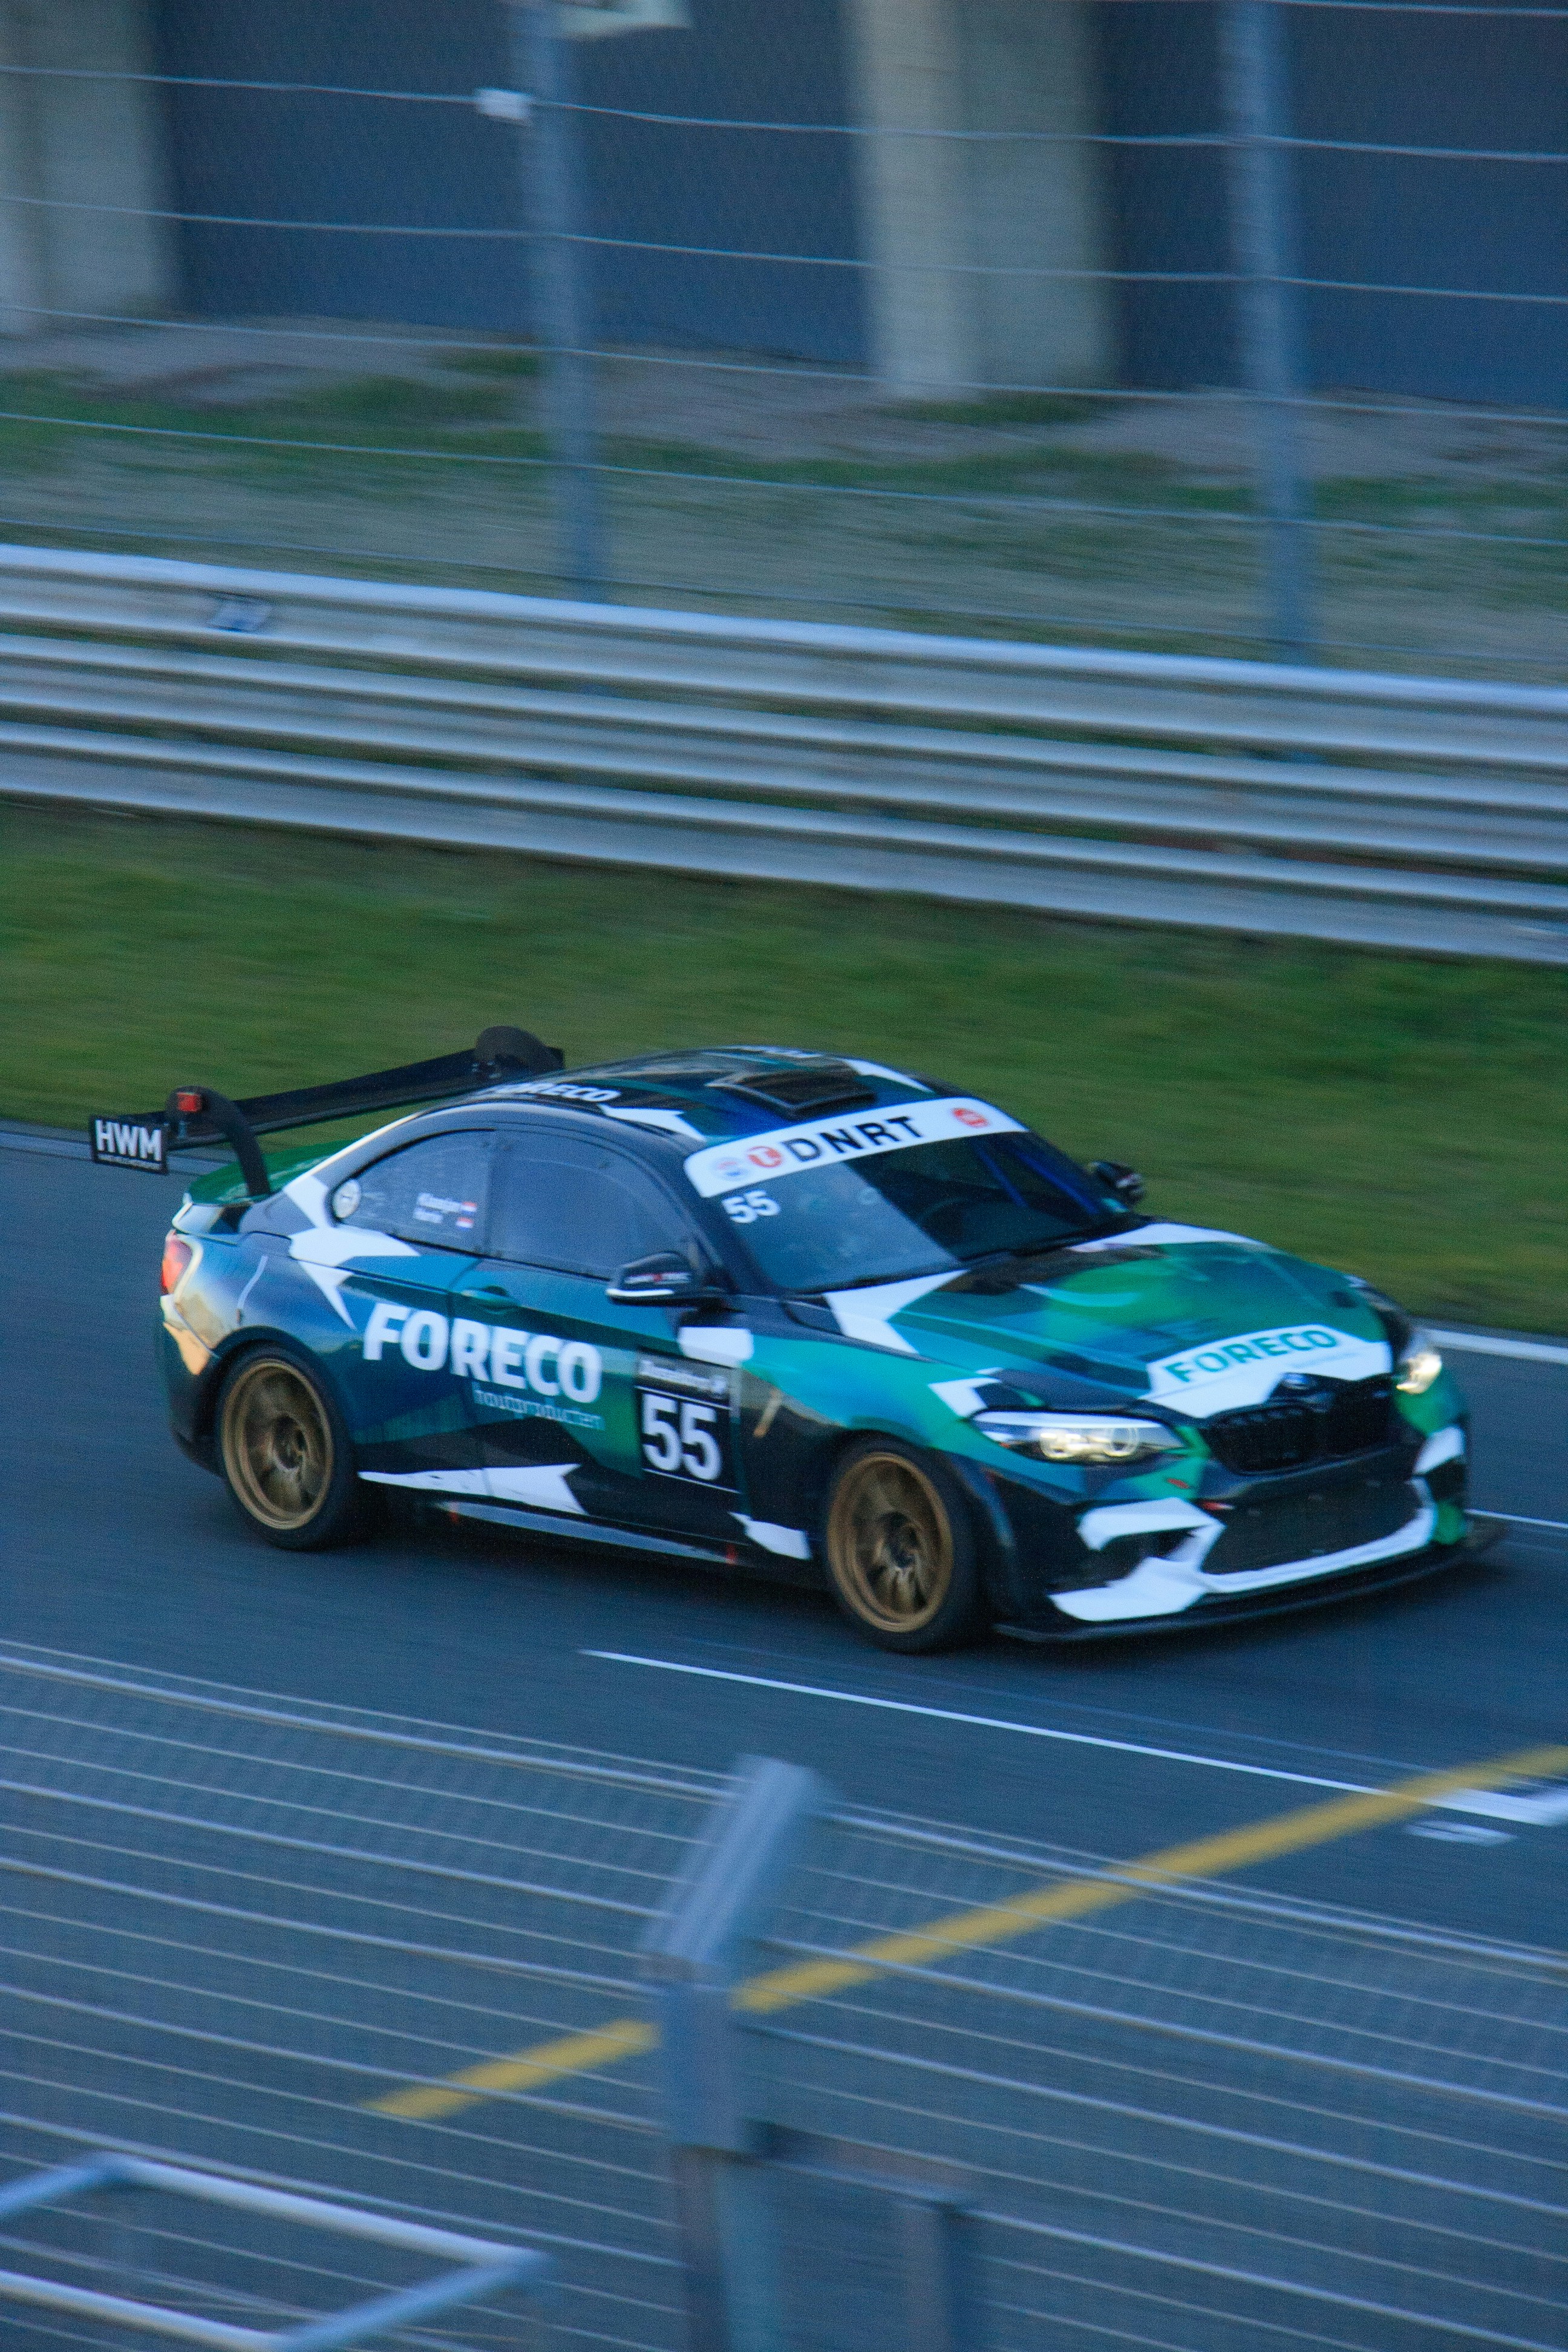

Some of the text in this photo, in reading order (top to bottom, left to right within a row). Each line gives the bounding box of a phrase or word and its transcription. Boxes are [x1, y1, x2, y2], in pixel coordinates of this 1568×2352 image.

[95, 1119, 162, 1161] HWM
[780, 1116, 923, 1161] DNRT
[723, 1189, 781, 1224] 55
[363, 1303, 602, 1403] FORECO
[1165, 1330, 1337, 1383] FORECO
[642, 1393, 722, 1480] 55
